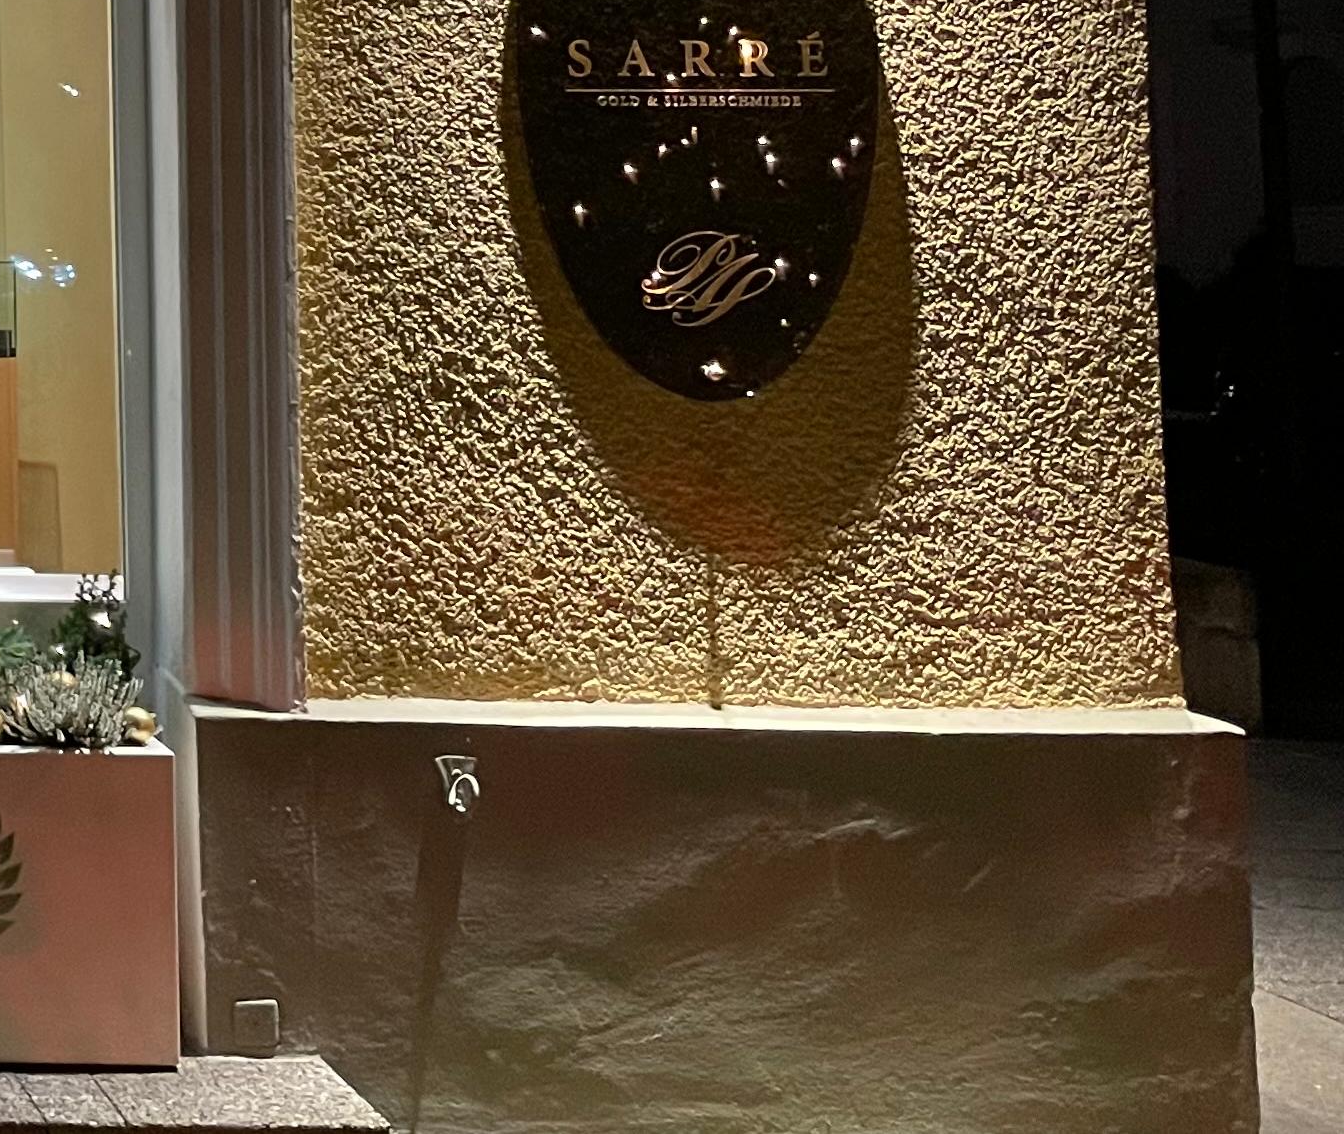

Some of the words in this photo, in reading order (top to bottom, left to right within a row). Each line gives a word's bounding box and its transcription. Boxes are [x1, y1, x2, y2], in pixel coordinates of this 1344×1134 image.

[567, 31, 829, 78] SARRÉ
[597, 95, 640, 107] GOLD
[647, 95, 658, 107] &
[663, 95, 803, 108] SILBERSCHMIEDE
